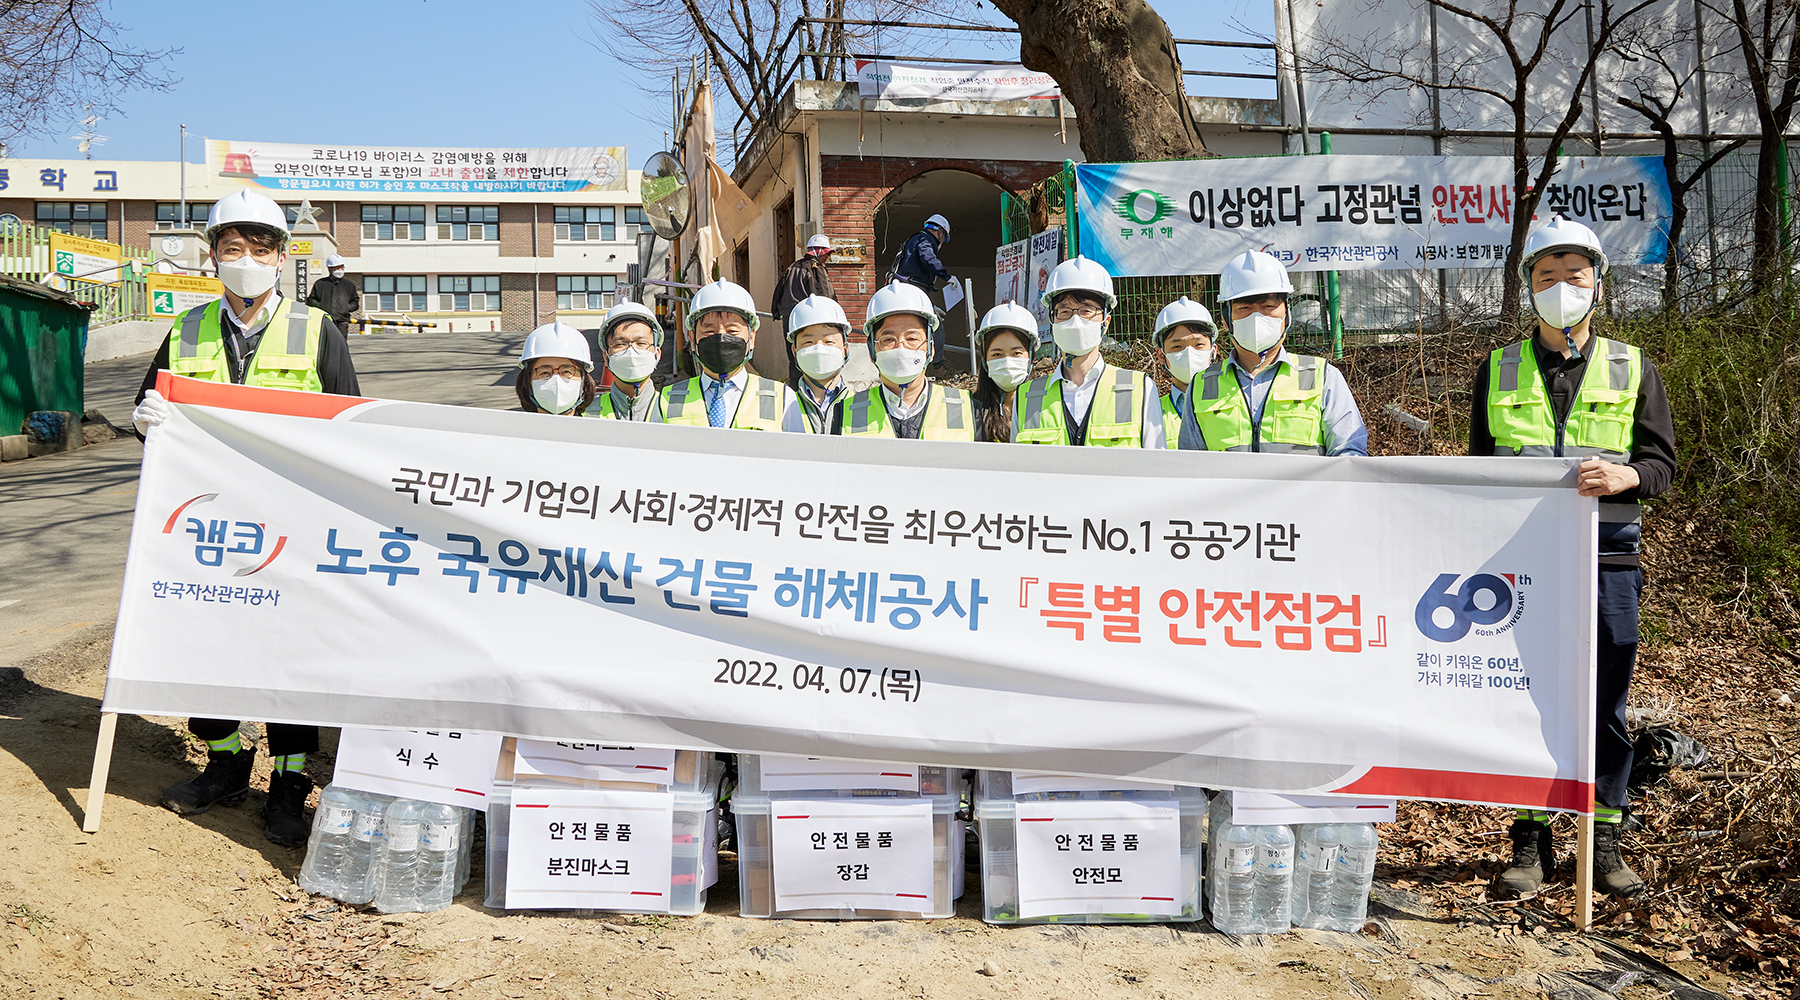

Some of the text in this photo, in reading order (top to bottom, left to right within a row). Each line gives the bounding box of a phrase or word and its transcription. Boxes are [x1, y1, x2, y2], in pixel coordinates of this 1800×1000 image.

[312, 149, 527, 165] 코로나19 바이러스 감염예방을 위해
[274, 163, 568, 180] 외부인(학부모님 포함)의 교내 출입을 제한합니다
[278, 178, 566, 192] 방문필요시 사전 허가 승인 후 마스크착용 내방하시기 바랍니다
[1188, 185, 1305, 229] 이상없다
[1317, 184, 1422, 225] 고정관념
[1547, 182, 1647, 221] 찾아온다
[1120, 226, 1173, 240] 무재해
[1305, 245, 1399, 262] 한국자산관리공사
[997, 254, 1026, 275] 접근금지
[391, 467, 1301, 562] 국민과 기업의 사회·경제적 안전을 최우선하는 No.1 공공기관
[185, 517, 265, 567] 캠코
[315, 527, 420, 586] 노후
[437, 532, 642, 606] 국유재산
[656, 557, 758, 618] 건물
[773, 565, 989, 632] 해체공사
[151, 580, 281, 606] 한국자산관리공사
[1495, 590, 1525, 636] ANNIVERSARY
[1416, 652, 1524, 673] 같이 키워온 60년,
[714, 658, 783, 691] 2022.
[792, 664, 830, 694] 04.
[1417, 671, 1530, 691] 가치 키워갈 100년!
[547, 857, 631, 877] 분진마스크
[836, 863, 870, 881] 장갑
[1071, 867, 1123, 885] 안전모
